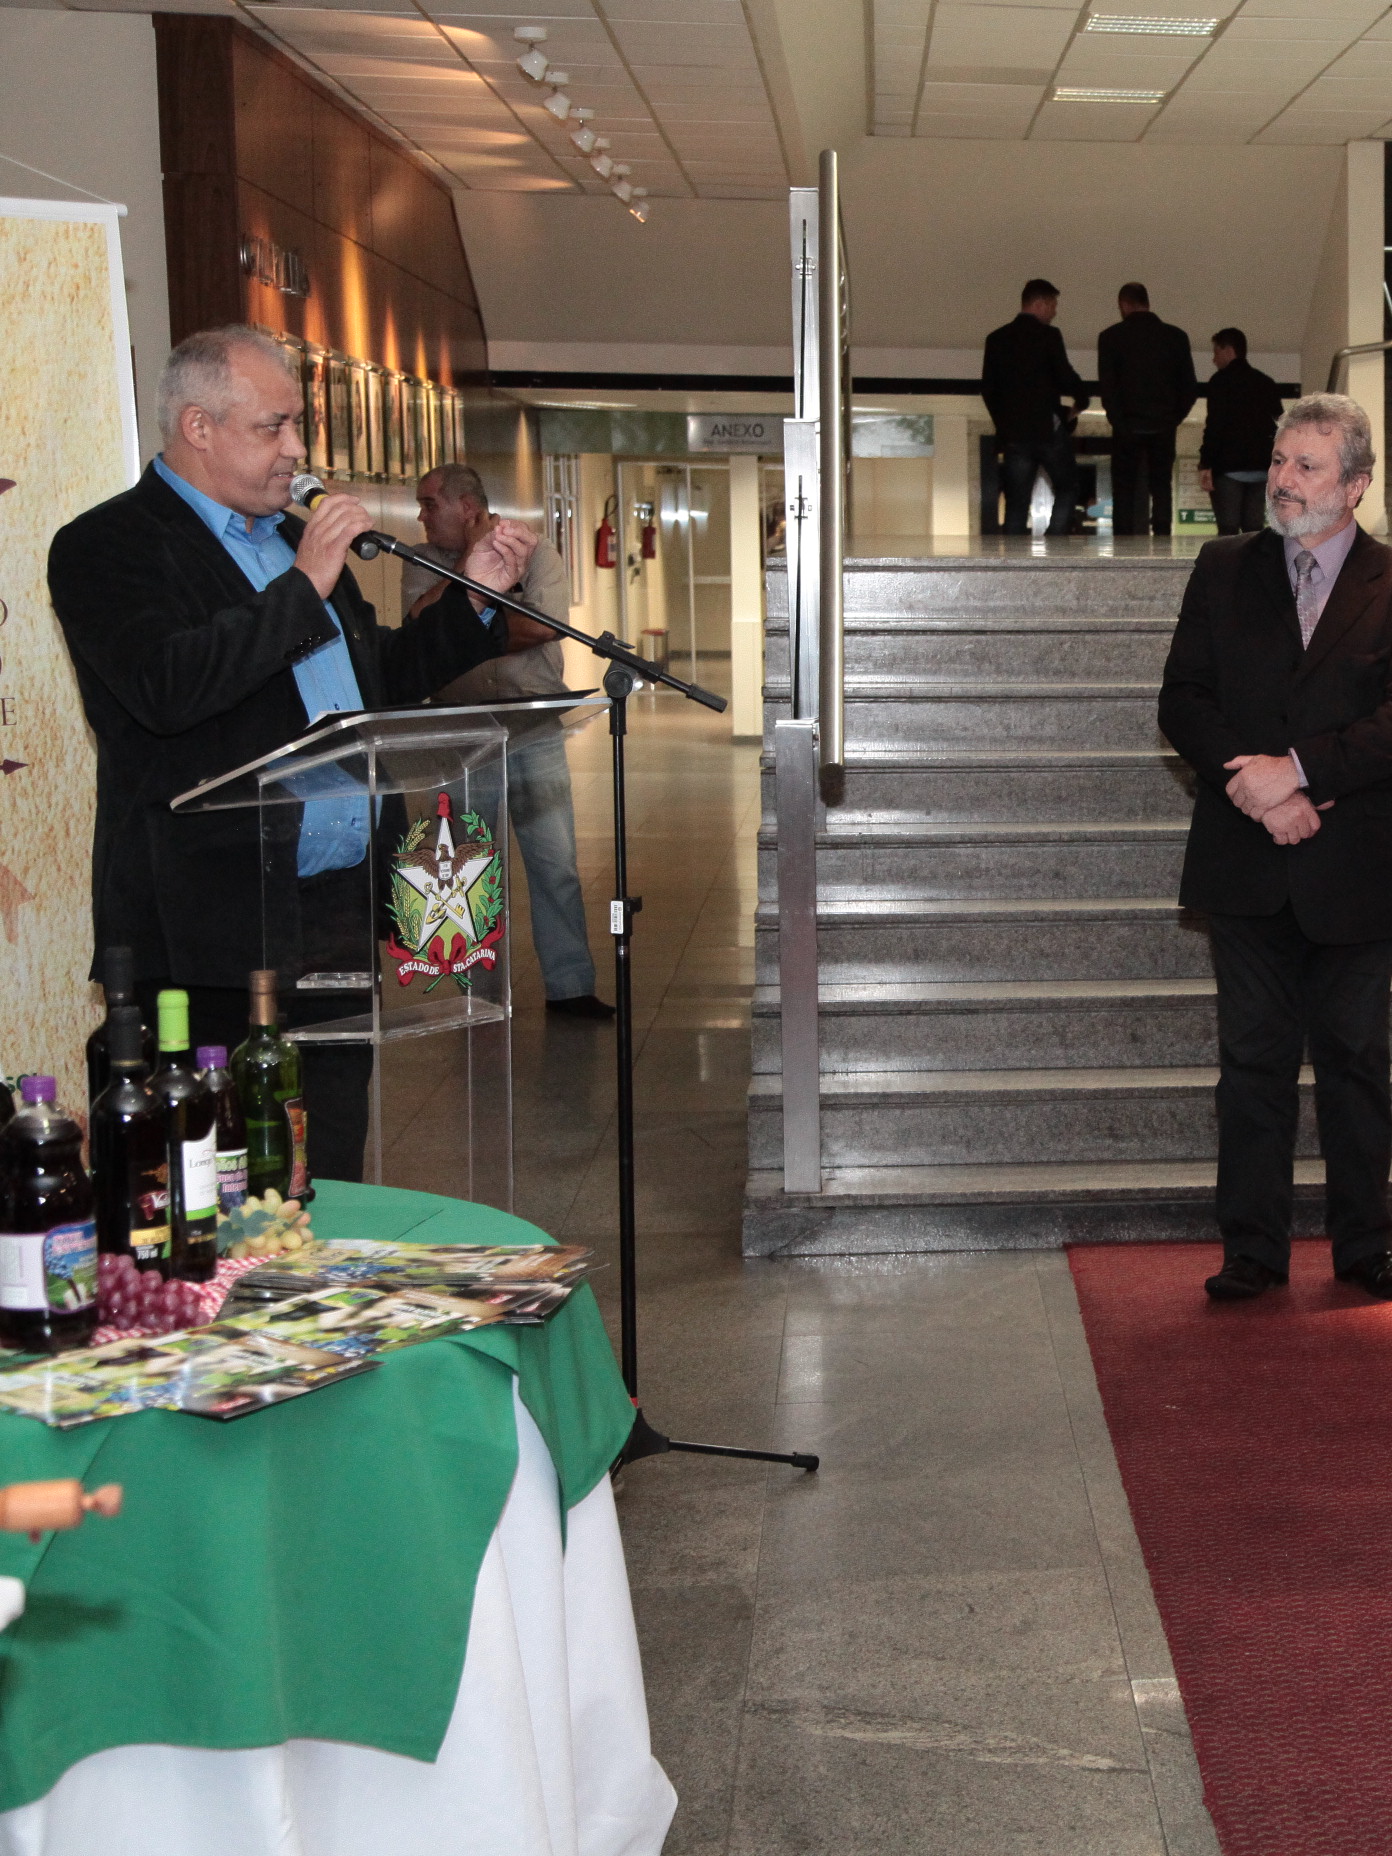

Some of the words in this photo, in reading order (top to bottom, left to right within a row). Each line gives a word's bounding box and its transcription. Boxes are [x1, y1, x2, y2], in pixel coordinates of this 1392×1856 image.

[711, 423, 764, 438] ANEXO
[399, 961, 429, 977] ESTADO
[429, 966, 440, 976] DE
